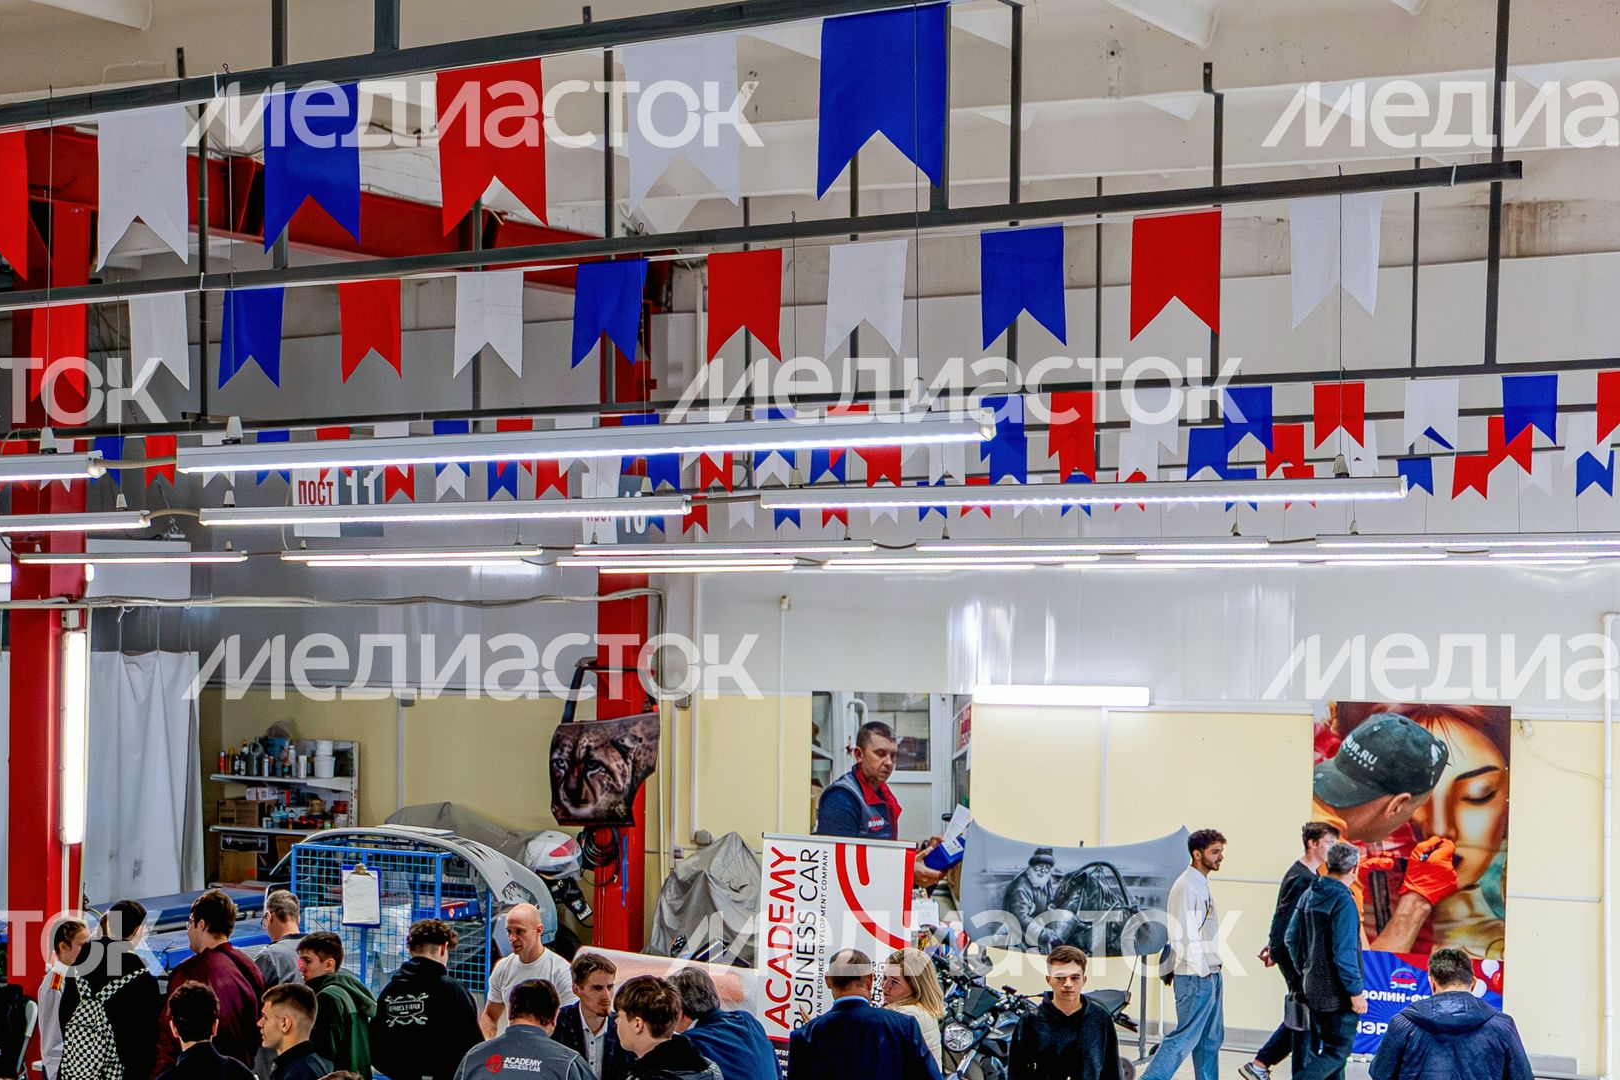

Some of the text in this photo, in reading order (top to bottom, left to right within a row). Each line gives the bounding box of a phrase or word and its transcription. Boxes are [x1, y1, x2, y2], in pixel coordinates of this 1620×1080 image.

[298, 480, 334, 505] ПОСТ
[799, 849, 819, 901] CAR
[764, 846, 796, 1030] ACADEMY
[504, 1056, 542, 1067] ACADEMY
